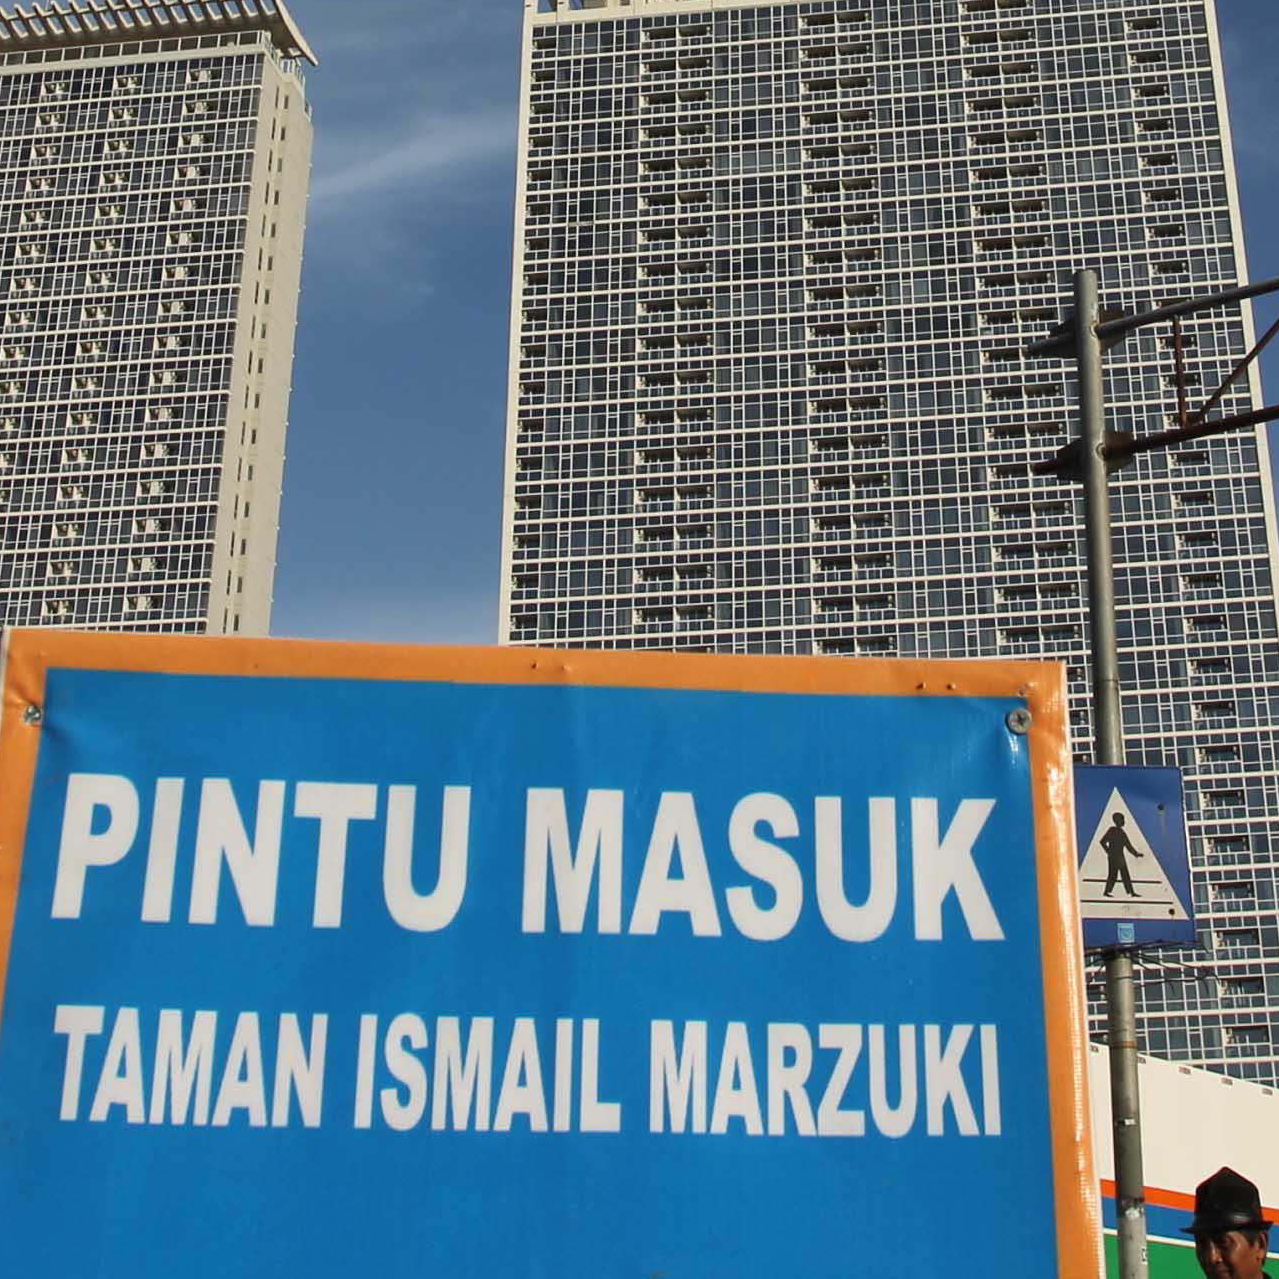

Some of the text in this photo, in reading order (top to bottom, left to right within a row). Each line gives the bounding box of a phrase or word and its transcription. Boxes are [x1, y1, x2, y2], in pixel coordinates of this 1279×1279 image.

[51, 772, 1005, 943] PINTU MASUK
[54, 1004, 1002, 1138] TAMAN ISMAIL MARZUKI
